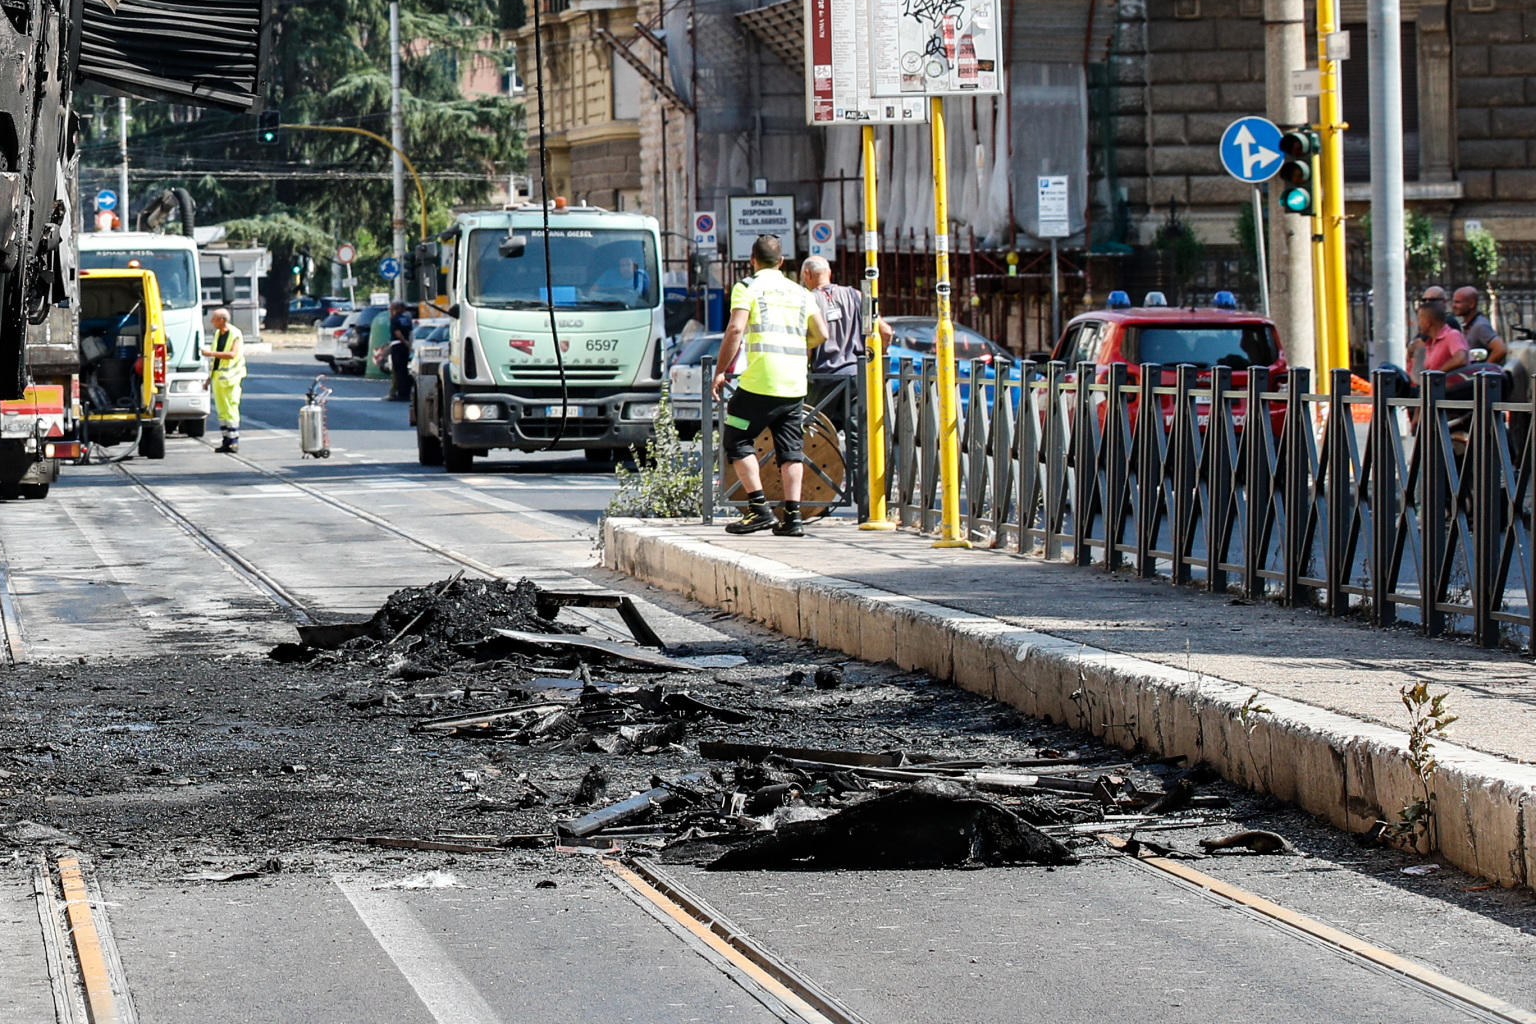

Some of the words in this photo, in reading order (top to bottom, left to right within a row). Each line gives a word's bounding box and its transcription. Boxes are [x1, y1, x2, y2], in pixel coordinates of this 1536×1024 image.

[531, 230, 565, 238] ROANA
[566, 230, 593, 238] DIESEL
[544, 319, 584, 328] IECO
[585, 339, 619, 352] 6597
